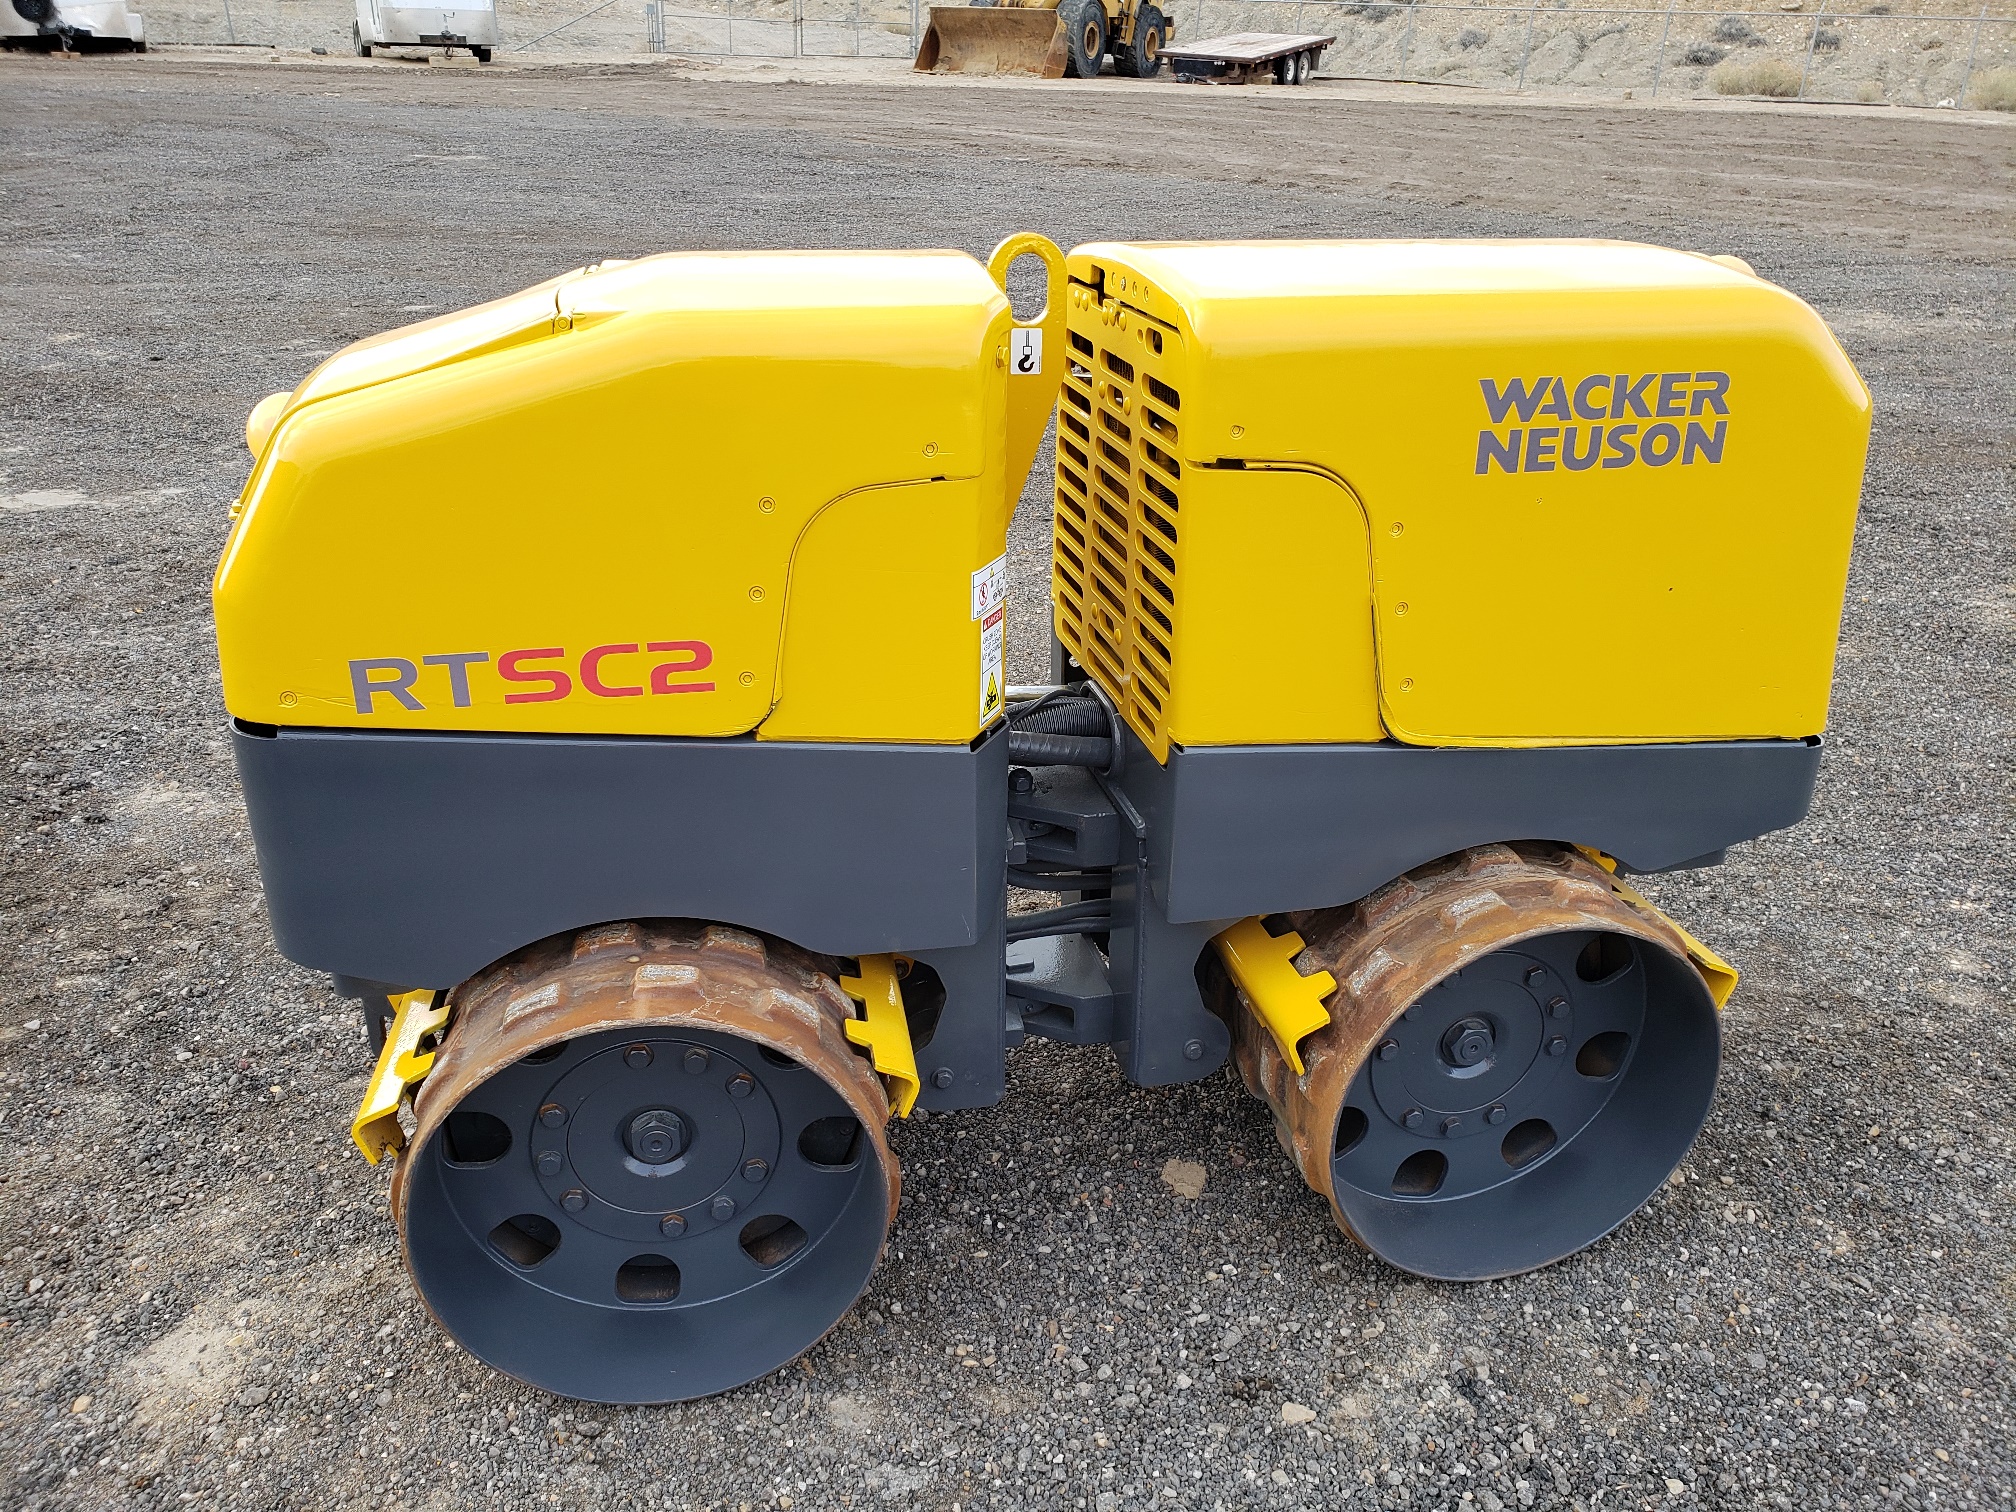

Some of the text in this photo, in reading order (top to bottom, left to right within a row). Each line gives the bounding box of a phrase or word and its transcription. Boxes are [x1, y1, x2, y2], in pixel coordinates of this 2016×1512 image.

[1479, 371, 1731, 424] WACKER
[1474, 420, 1729, 475] NEUSON
[348, 640, 716, 714] RTSC2
